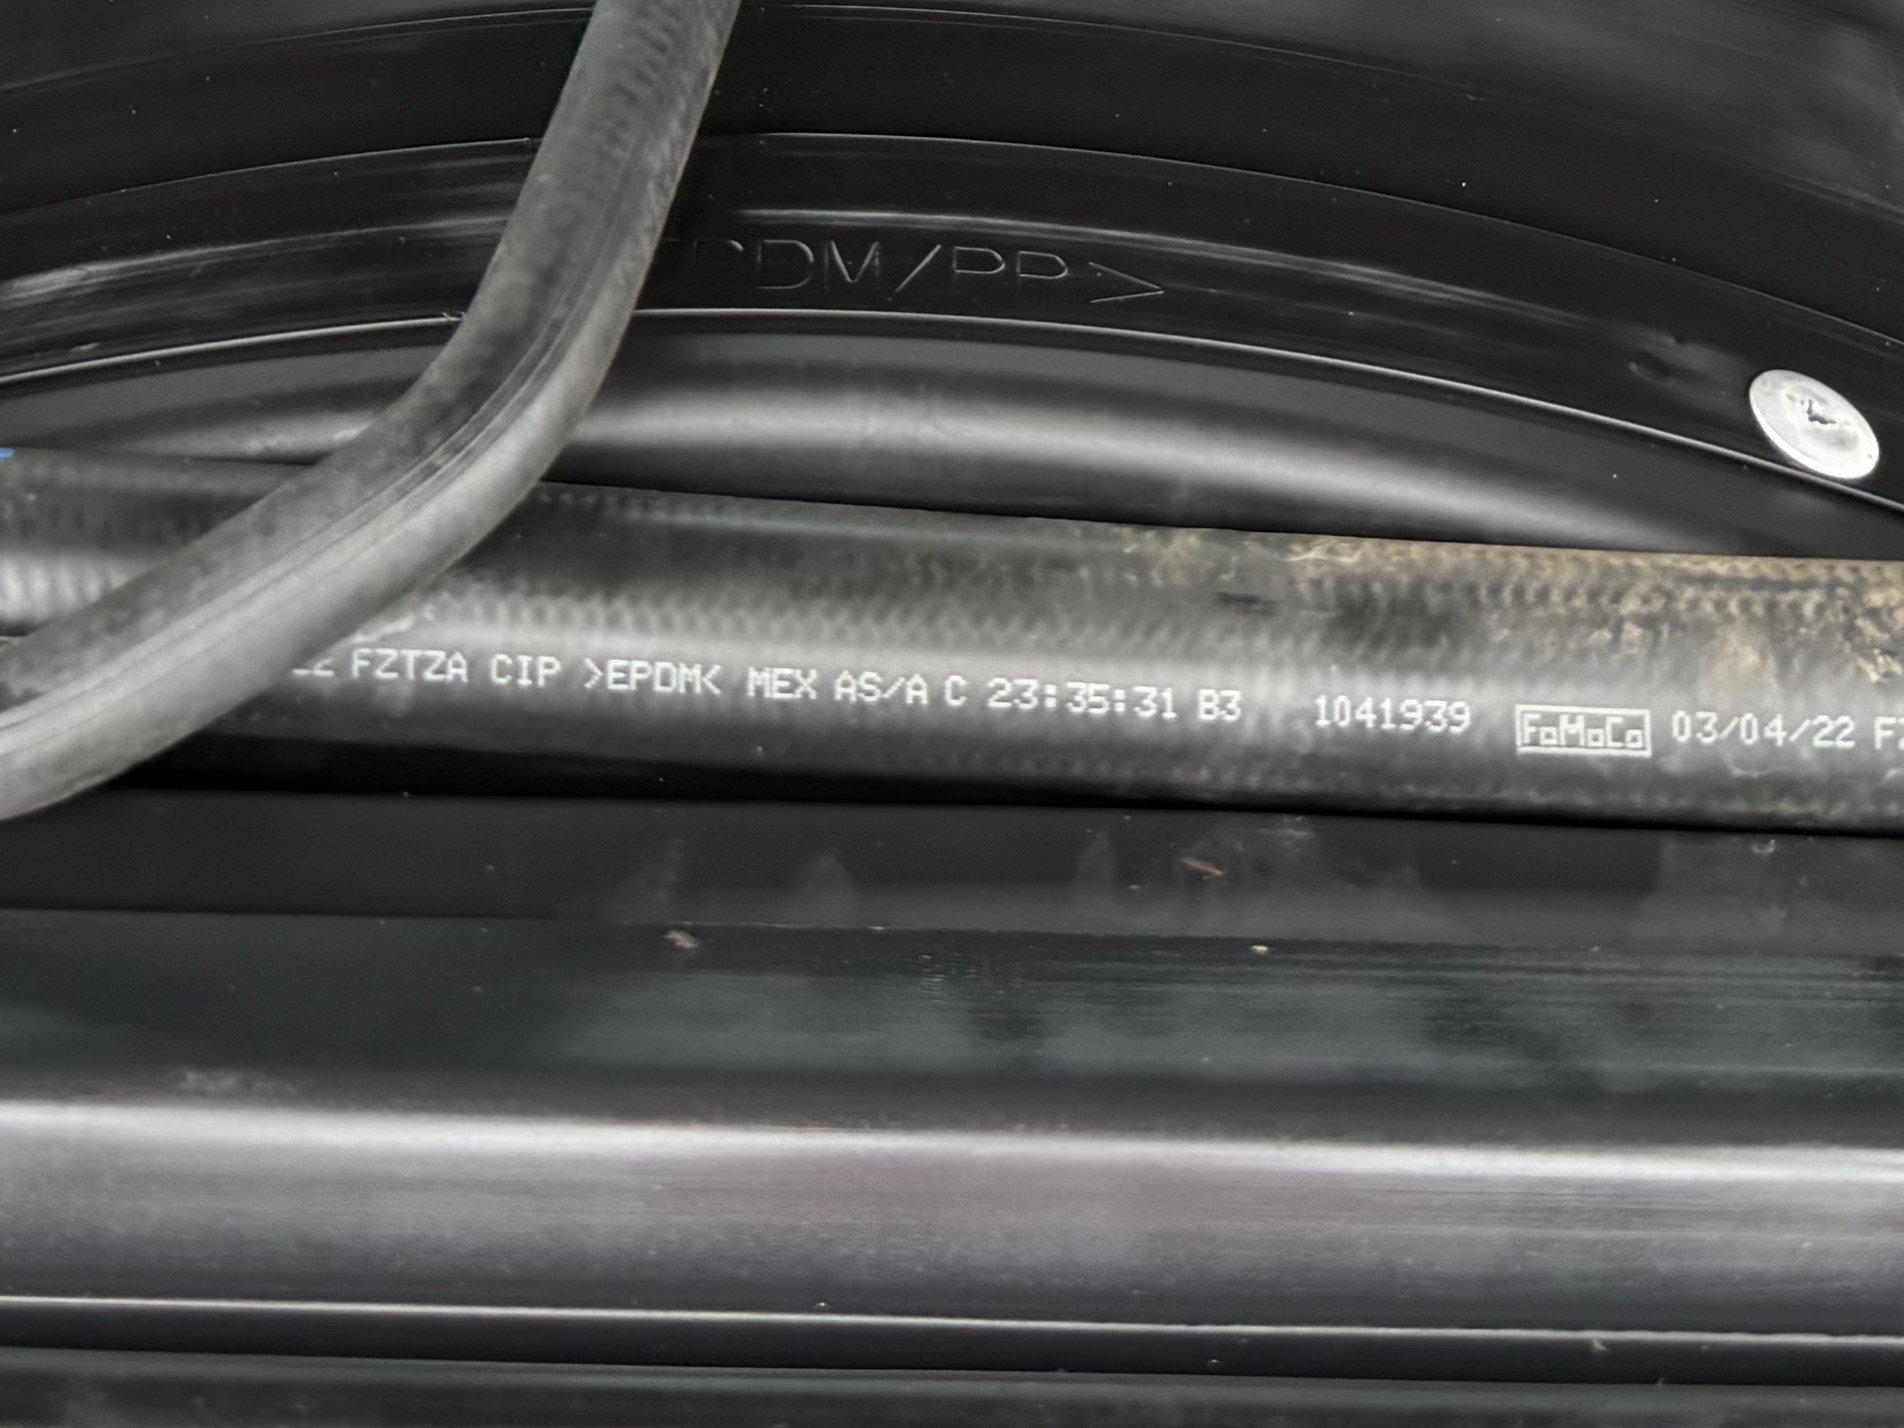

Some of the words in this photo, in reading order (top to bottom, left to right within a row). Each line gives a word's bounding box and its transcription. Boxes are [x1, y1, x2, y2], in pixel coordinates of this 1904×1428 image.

[351, 647, 469, 684] FZTZA
[489, 653, 562, 689] CIP
[583, 657, 722, 696] >EPDM<
[747, 666, 818, 701] MEX
[833, 669, 929, 705] AS/A
[943, 674, 969, 707] C
[986, 676, 1178, 719] 23:35:31
[1197, 688, 1243, 722] B3
[1313, 693, 1473, 735] 1041939
[1522, 711, 1645, 751] FoMoCo
[1670, 710, 1857, 749] 03/04/22
